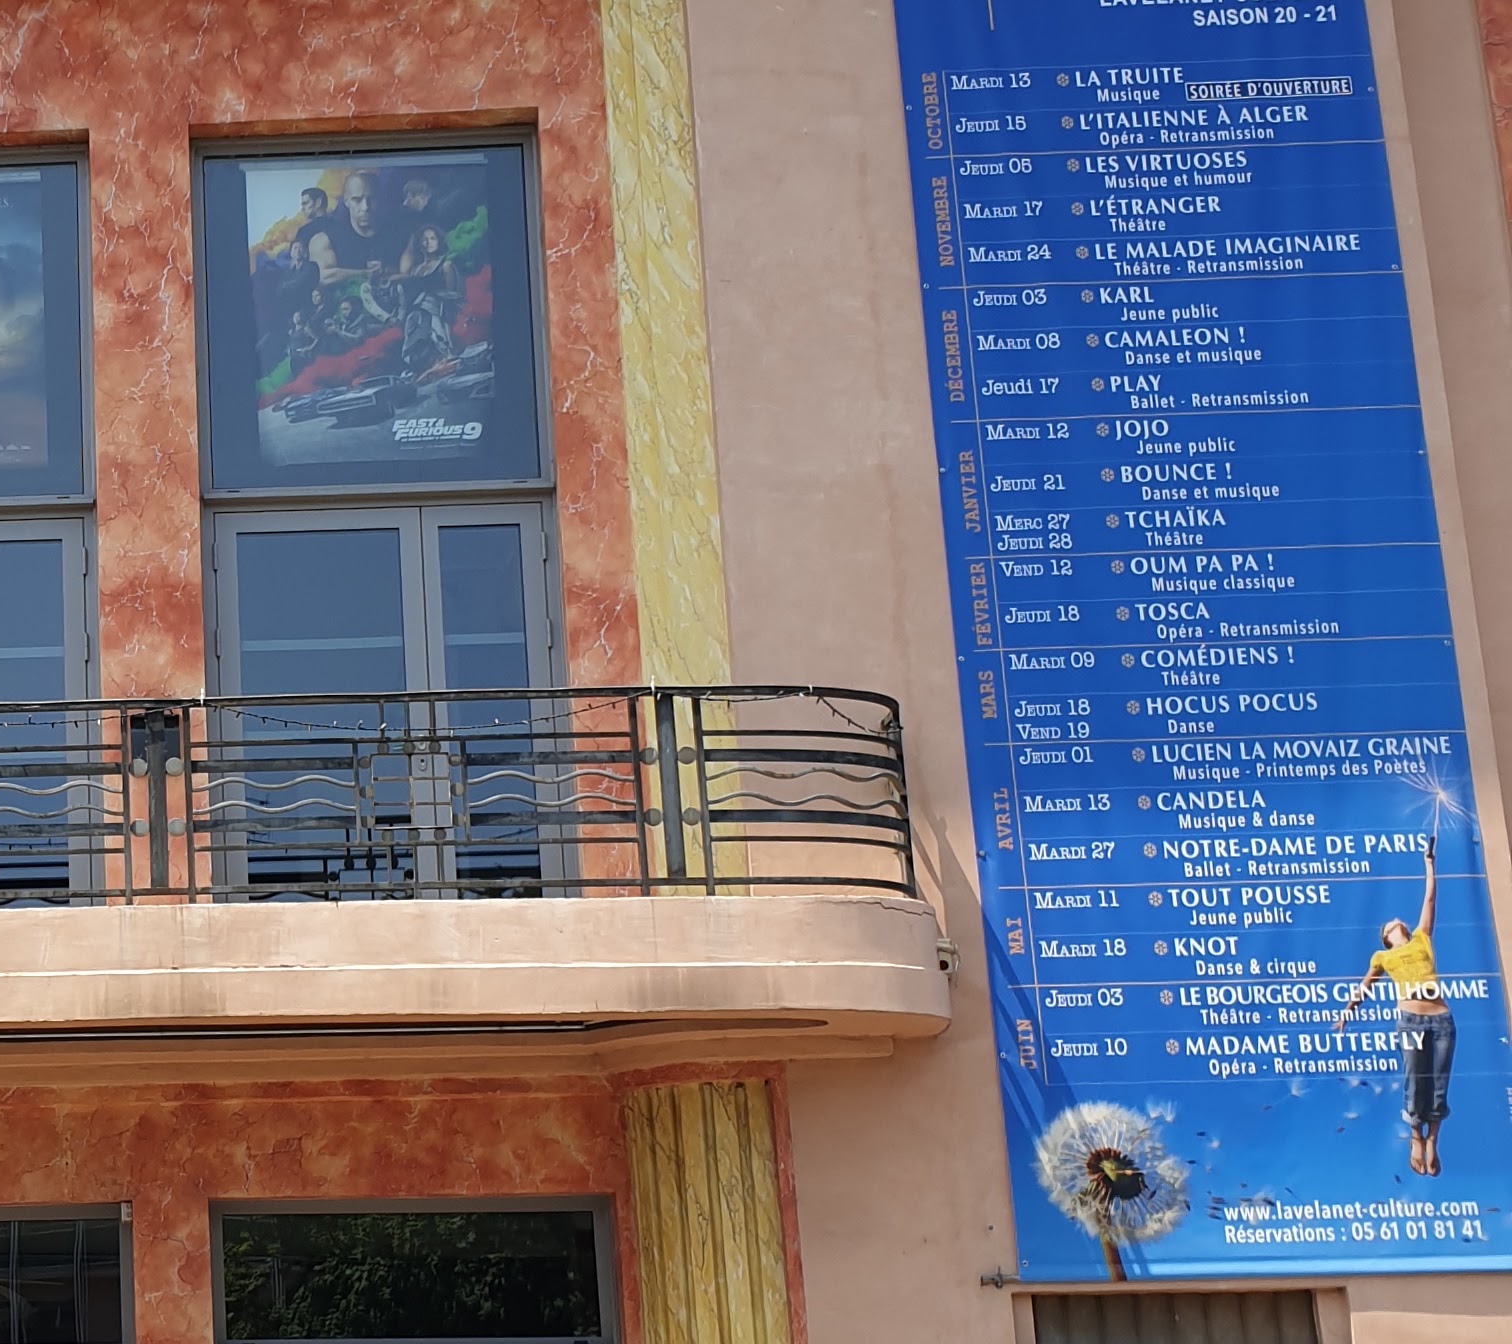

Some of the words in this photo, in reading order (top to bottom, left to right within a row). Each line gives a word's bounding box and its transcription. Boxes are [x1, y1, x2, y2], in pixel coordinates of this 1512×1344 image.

[1193, 7, 1268, 26] SAISON
[1275, 7, 1296, 23] 20
[1316, 5, 1336, 21] 21
[1076, 71, 1100, 86] LA
[1107, 68, 1183, 85] TRUITE
[1097, 87, 1159, 104] Musique
[1189, 80, 1242, 101] SOIRÉE
[1247, 78, 1350, 97] D'OUVERTURE
[922, 73, 942, 149] OCTOBRE
[1080, 110, 1208, 129] L'ITALIENNE
[1218, 105, 1230, 124] À
[1240, 106, 1308, 123] ALGER
[1006, 116, 1026, 130] 15
[1100, 131, 1143, 148] Opéra
[1161, 126, 1273, 142] Retransmission
[1086, 156, 1119, 172] LES
[1124, 150, 1246, 171] VIRTUOSES
[1105, 174, 1167, 191] Musique
[1174, 174, 1188, 186] et
[1194, 171, 1251, 185] humour
[1091, 195, 1220, 215] L'ÉTRANGER
[932, 176, 956, 266] NOVEMBRE
[1110, 218, 1165, 231] Théâtre
[1095, 243, 1117, 259] LE
[1127, 240, 1216, 258] MALADE
[1226, 234, 1360, 254] IMAGINAIRE
[1100, 287, 1154, 303] KARL
[1121, 307, 1165, 321] Jeune
[1172, 304, 1218, 323] public
[1105, 328, 1228, 347] CAMALEON
[942, 311, 964, 401] DÉCEMBRE
[1126, 351, 1170, 364] Danse
[982, 379, 1033, 395] Jeudi
[1040, 378, 1059, 393] 17
[1110, 375, 1160, 392] PLAY
[394, 425, 464, 441] FURIOUS
[462, 422, 482, 440] 9
[1116, 420, 1168, 440] JOJO
[1121, 464, 1216, 482] BOUNCE
[958, 451, 980, 532] JANVIER
[1125, 506, 1225, 528] TCHAÏKA
[1131, 557, 1187, 574] OUM
[1196, 556, 1222, 572] PA
[1232, 554, 1258, 571] PA
[1224, 574, 1294, 592] classique
[968, 562, 993, 645] FÉVRIER
[1135, 603, 1209, 620] TOSCA
[1141, 643, 1278, 667] COMÉDIENS
[978, 671, 997, 719] MARS
[1147, 696, 1229, 715] HOCUS
[1239, 693, 1317, 711] POCUS
[1152, 743, 1231, 762] LUCIEN
[1240, 742, 1266, 759] LA
[1274, 740, 1360, 758] MOVAIZ
[1368, 737, 1451, 757] GRAINE
[1257, 763, 1339, 780] Printemps
[1342, 760, 1368, 775] des
[1374, 758, 1426, 774] Poètes
[1157, 790, 1266, 810] CANDELA
[993, 788, 1013, 850] AVRIL
[1163, 837, 1316, 858] NOTRE-DAME
[1326, 836, 1355, 854] DE
[1364, 834, 1431, 853] PARIS
[1168, 888, 1231, 907] TOUT
[1242, 885, 1330, 905] POUSSE
[1006, 918, 1024, 954] MAI
[1174, 937, 1238, 956] KNOT
[1267, 959, 1315, 977] cirque
[1180, 987, 1201, 1005] LE
[1206, 984, 1328, 1005] BOURGEOIS
[1333, 979, 1488, 1002] GENTILHOMME
[1016, 1019, 1036, 1069] JUIN
[1187, 1035, 1289, 1055] MADAME
[1299, 1032, 1424, 1052] BUTTERFLY
[1224, 1198, 1478, 1224] www.lavelanet-culture.com
[1225, 1223, 1335, 1243] Réservations
[1352, 1222, 1375, 1240] 05
[1380, 1222, 1399, 1240] 61
[1406, 1221, 1430, 1239] 01
[1434, 1220, 1454, 1239] 81
[1462, 1220, 1486, 1240] 41
